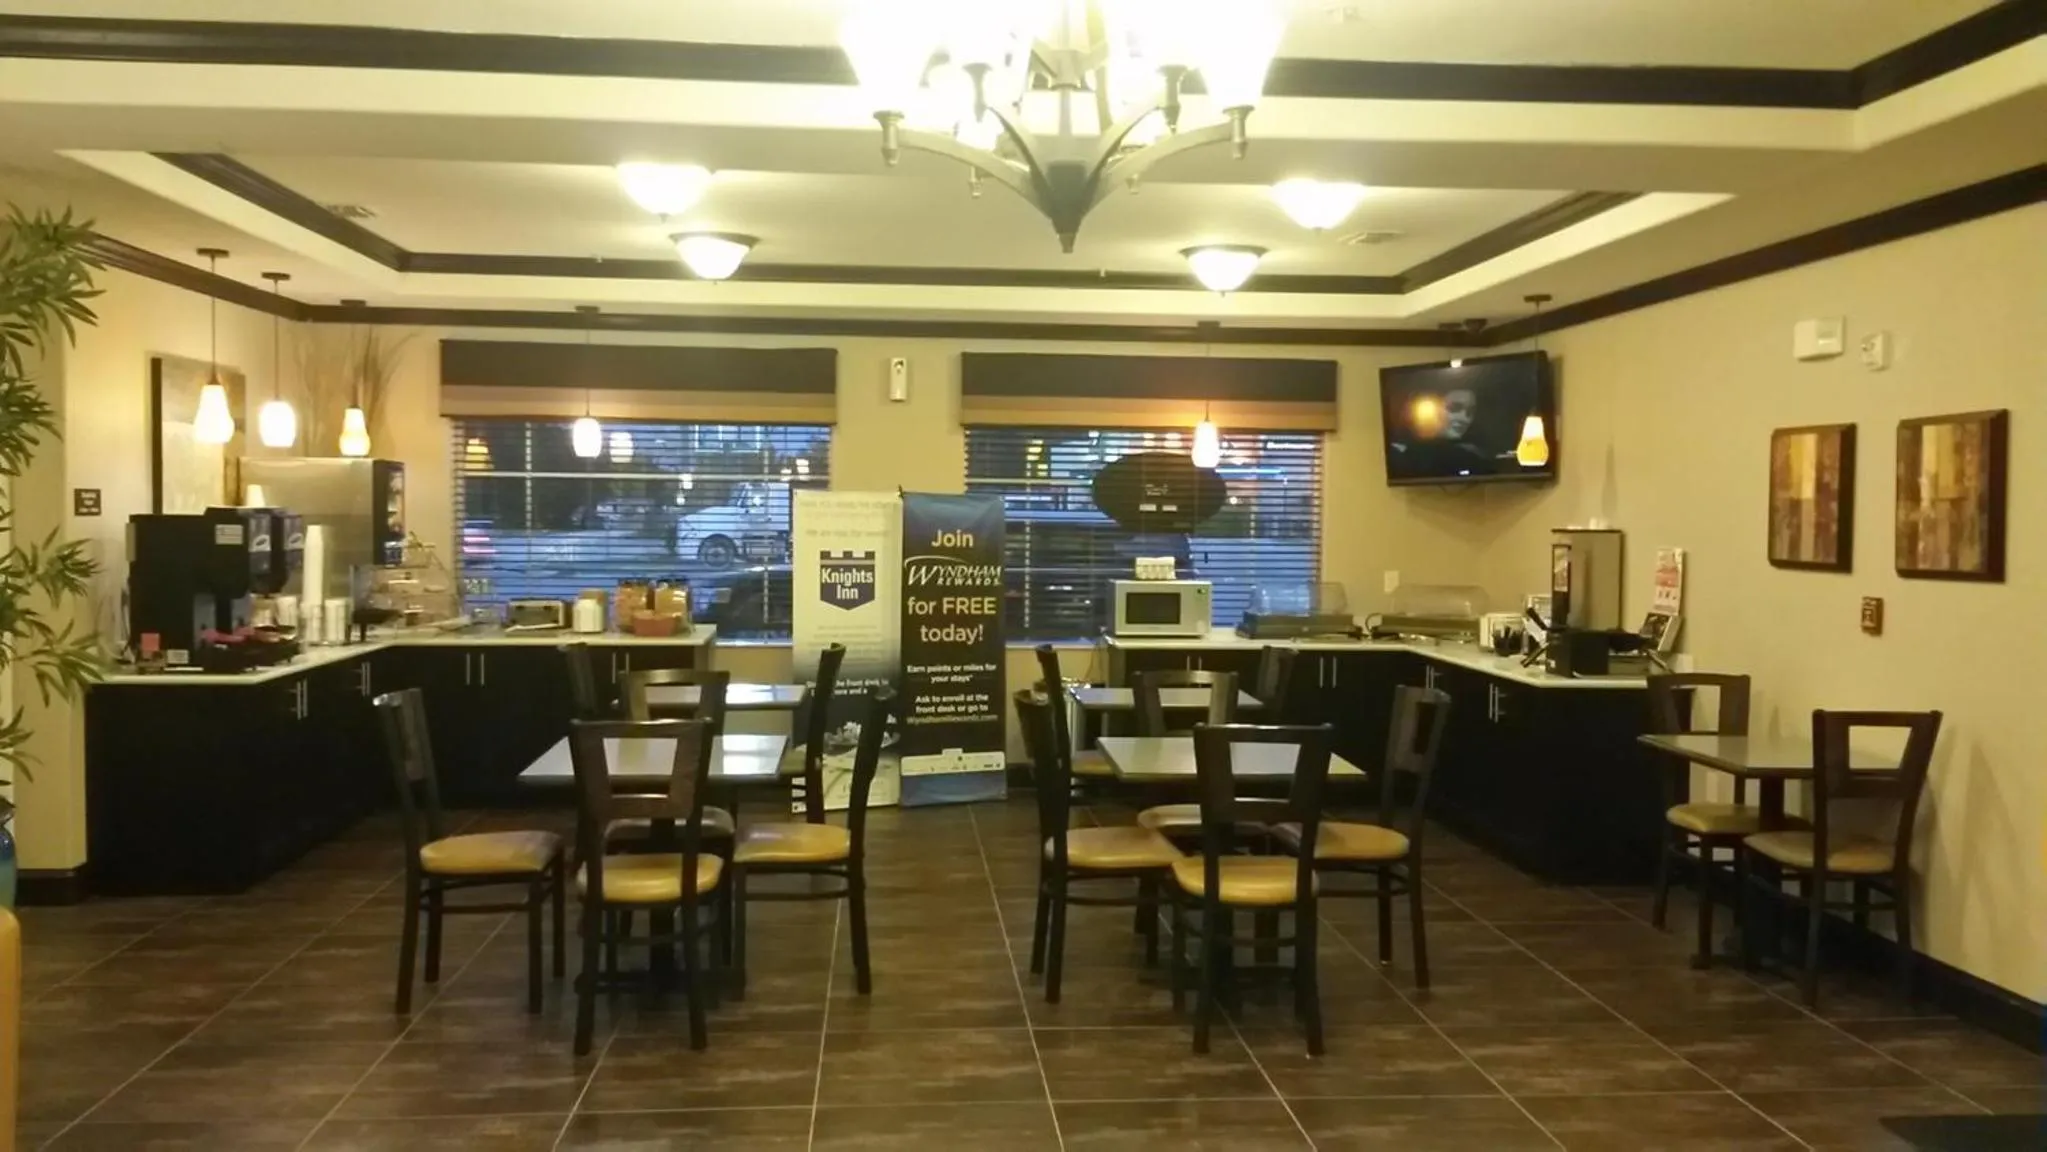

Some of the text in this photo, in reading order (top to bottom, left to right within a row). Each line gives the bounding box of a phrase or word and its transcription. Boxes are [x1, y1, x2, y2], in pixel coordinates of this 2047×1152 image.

[931, 529, 974, 547] Join
[822, 567, 874, 587] Knights
[908, 565, 1002, 586] WYNDHAM
[936, 577, 1001, 586] REWARDS
[836, 584, 859, 600] Inn
[907, 596, 997, 615] for FREE
[921, 623, 984, 645] today!
[906, 663, 997, 673] Earn points or miles for
[931, 675, 949, 684] your
[915, 694, 989, 704] Ask to enroll at the
[915, 705, 936, 714] front
[937, 704, 956, 713] desk
[967, 705, 979, 713] go
[979, 704, 989, 712] to
